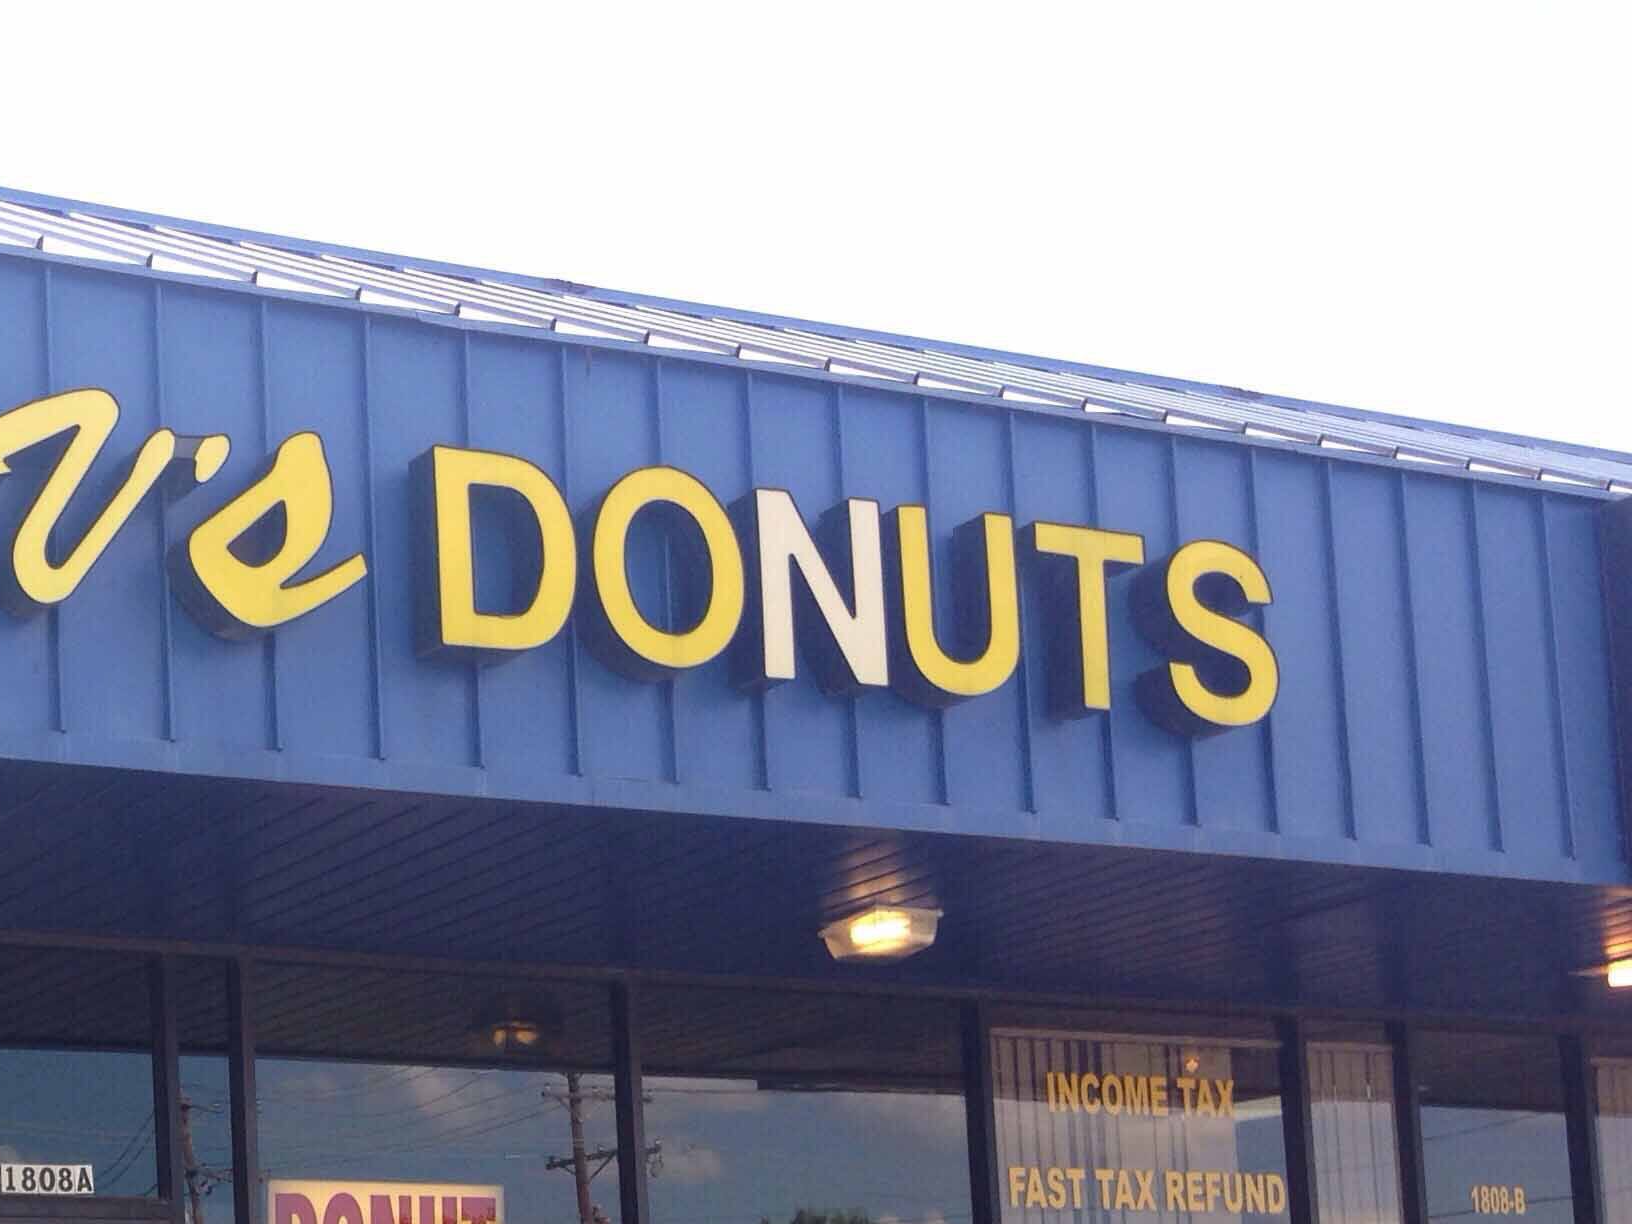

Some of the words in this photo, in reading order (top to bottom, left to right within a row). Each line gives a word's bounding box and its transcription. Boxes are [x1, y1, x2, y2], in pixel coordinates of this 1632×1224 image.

[432, 444, 1280, 728] DONUTS
[1047, 1072, 1168, 1116] INCOME
[1177, 1077, 1234, 1118] TAX
[4, 1166, 93, 1192] 1808A
[1009, 1167, 1085, 1209] FAST
[1096, 1168, 1157, 1211] TAX
[1166, 1170, 1287, 1214] REFUND
[1471, 1185, 1526, 1216] 1808-B
